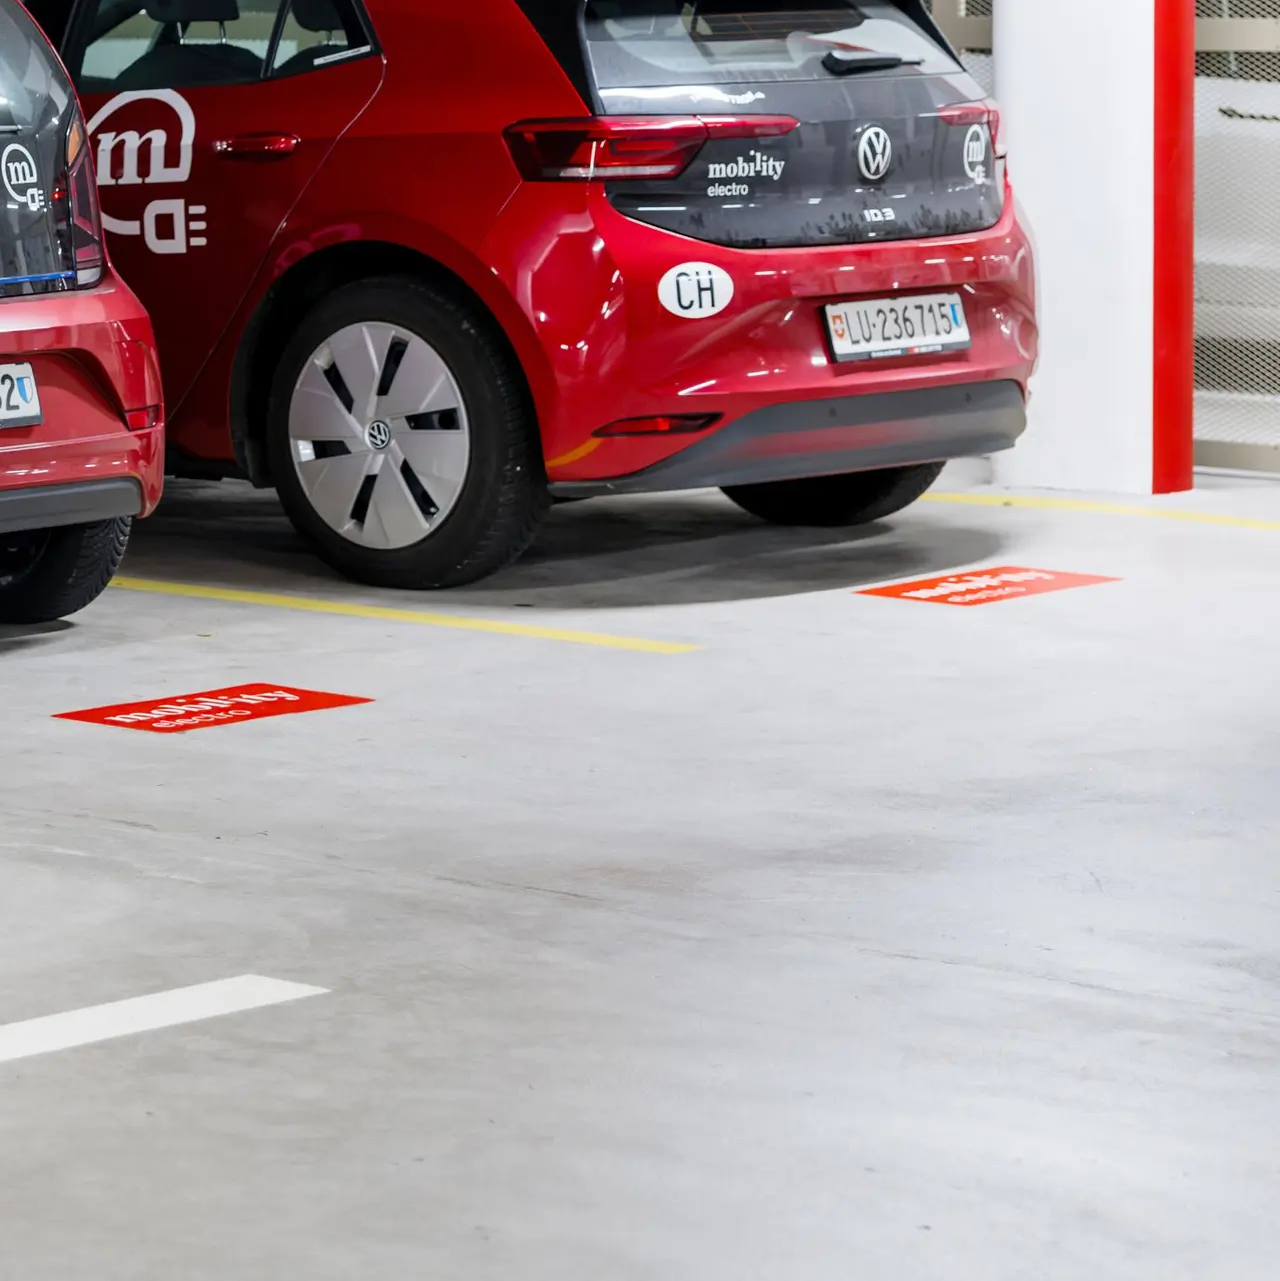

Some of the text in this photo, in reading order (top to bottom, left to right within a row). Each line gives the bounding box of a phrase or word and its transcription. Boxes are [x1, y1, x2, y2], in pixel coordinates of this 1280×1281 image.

[707, 149, 786, 180] mobility
[706, 182, 749, 197] electro
[675, 269, 716, 311] CH
[104, 690, 301, 723] mobility
[151, 709, 252, 728] electro
